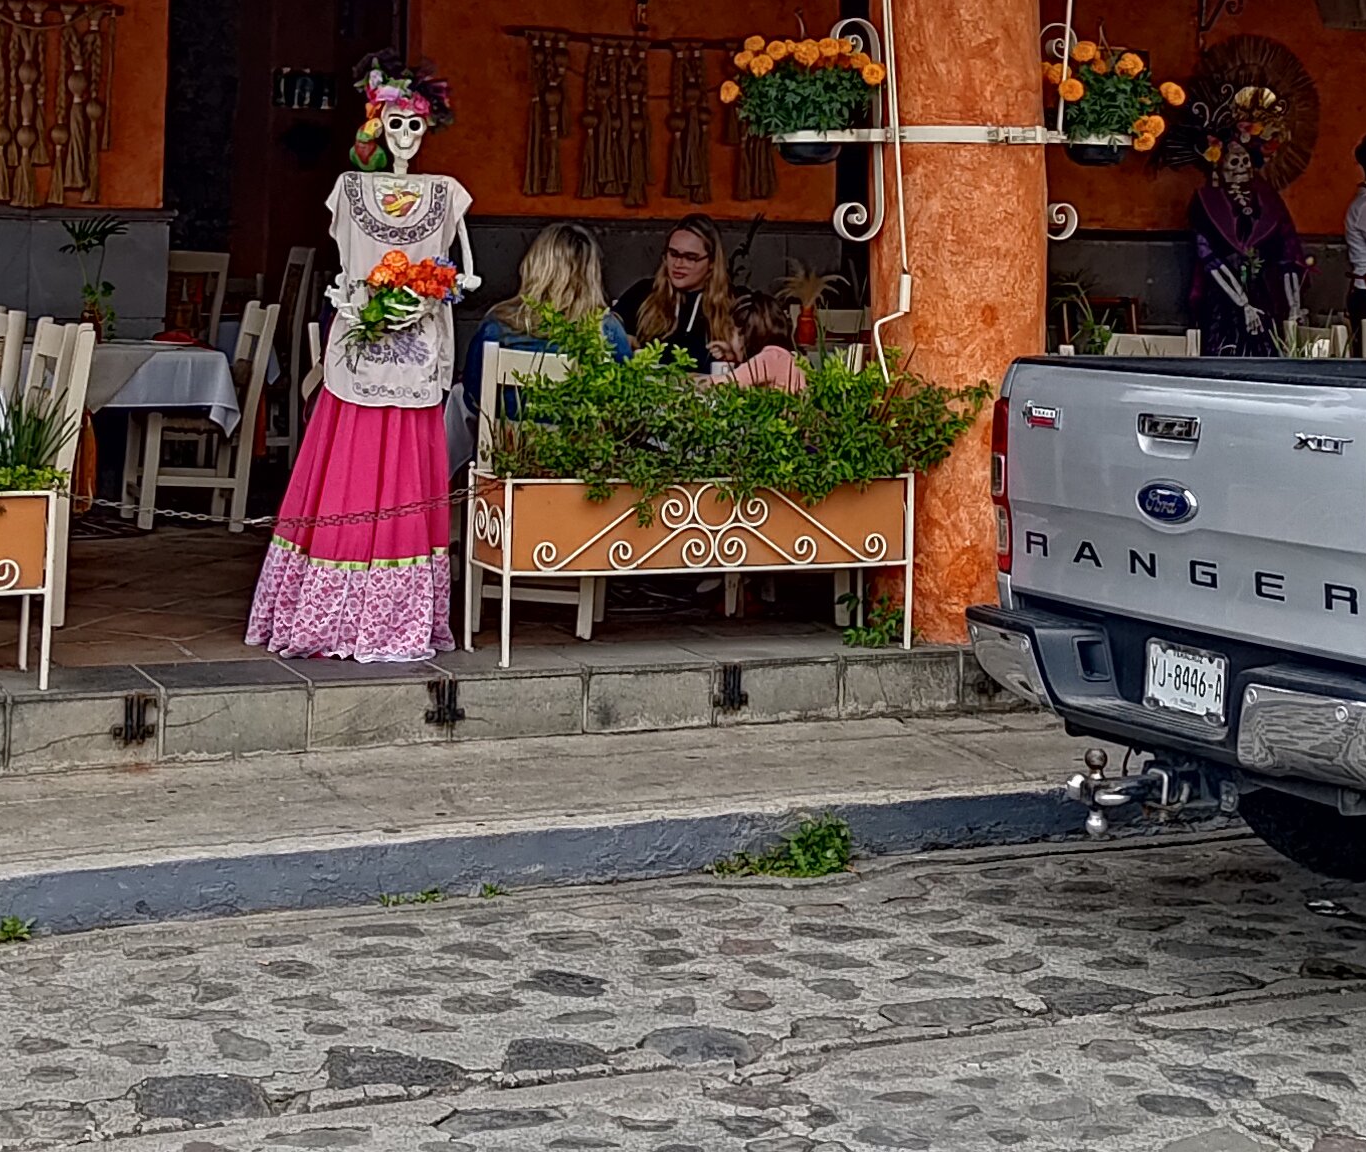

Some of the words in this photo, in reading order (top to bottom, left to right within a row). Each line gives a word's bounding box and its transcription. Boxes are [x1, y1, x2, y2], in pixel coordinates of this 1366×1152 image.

[1293, 432, 1354, 456] XLT
[1145, 489, 1181, 515] Ford
[1024, 531, 1359, 615] RANGER
